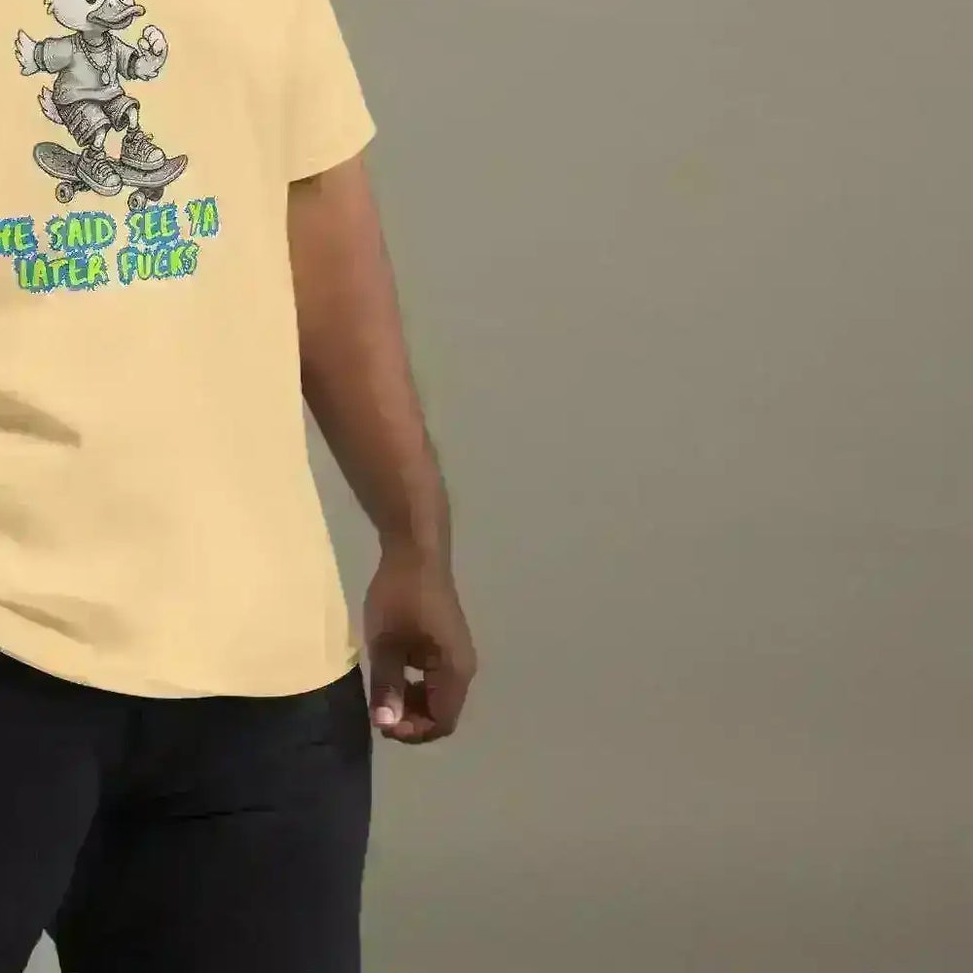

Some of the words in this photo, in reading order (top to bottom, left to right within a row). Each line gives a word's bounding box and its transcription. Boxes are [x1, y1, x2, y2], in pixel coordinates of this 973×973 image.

[47, 214, 115, 250] SAID
[127, 206, 178, 244] SEE
[186, 198, 219, 236] YA
[17, 253, 108, 291] LATER
[118, 243, 200, 283] FUCKS
